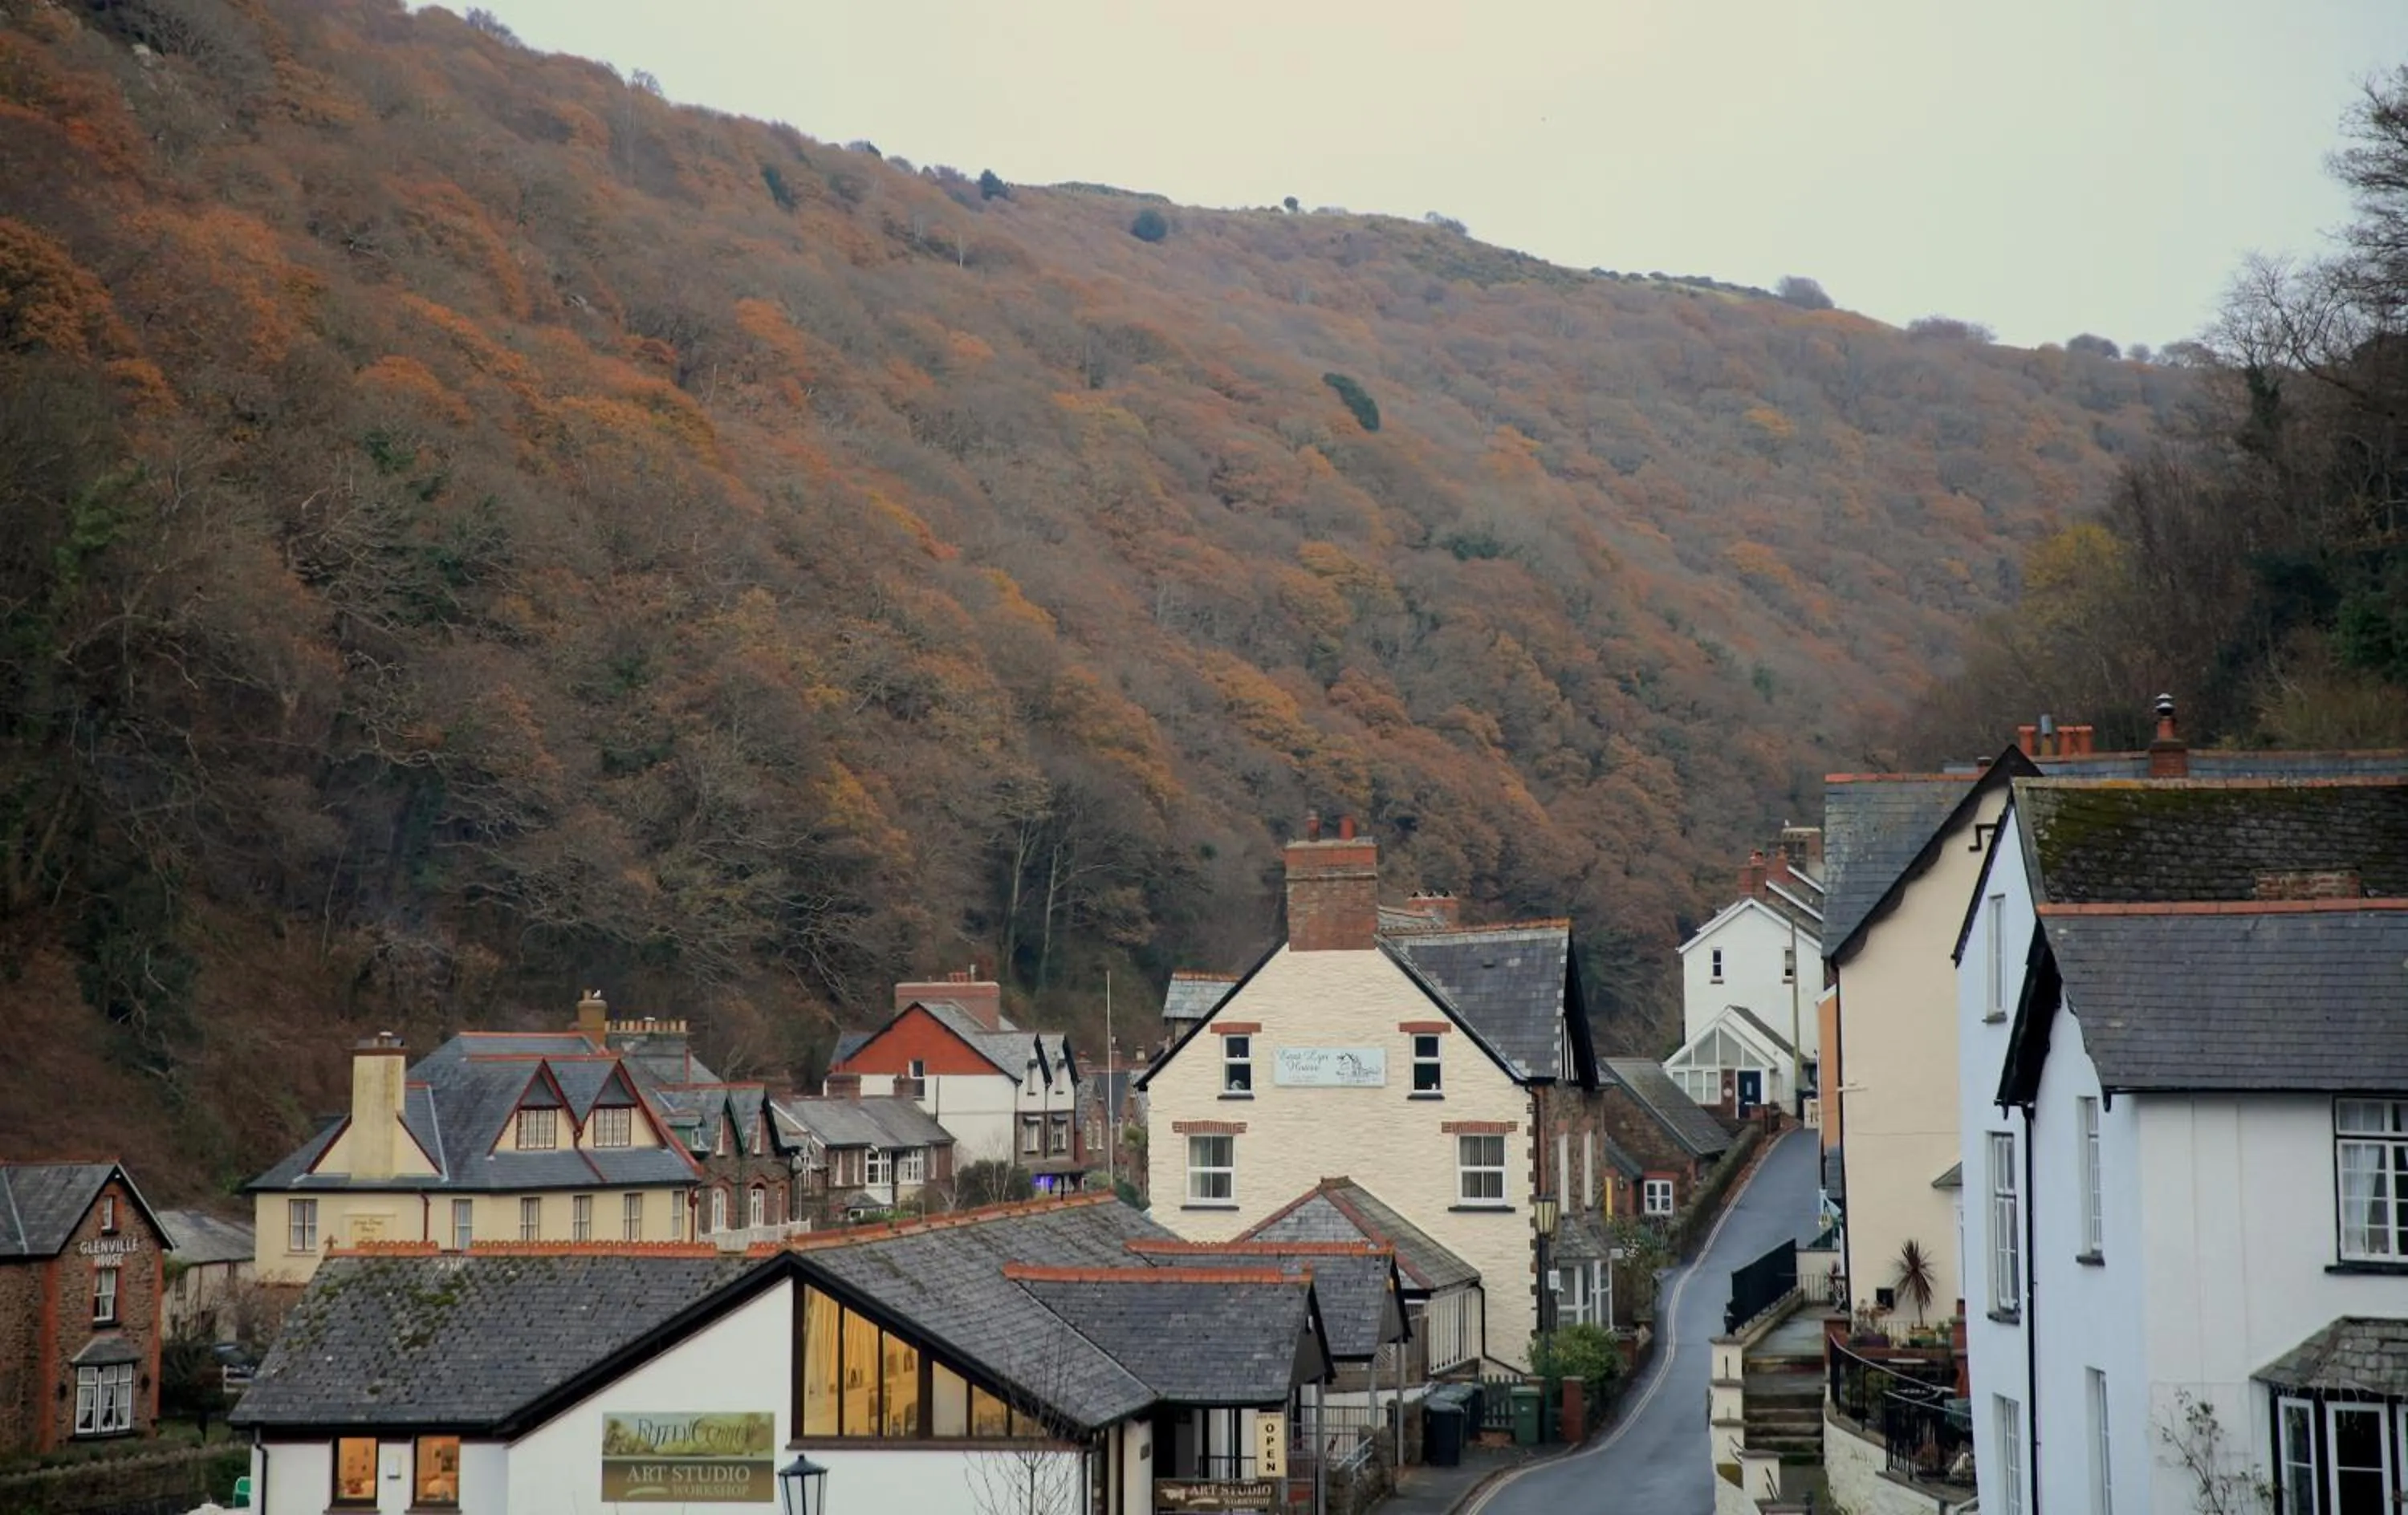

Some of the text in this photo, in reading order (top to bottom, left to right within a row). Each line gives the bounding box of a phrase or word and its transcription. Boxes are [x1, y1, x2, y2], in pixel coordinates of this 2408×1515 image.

[80, 1237, 138, 1254] GLENVILLE
[1265, 1424, 1275, 1472] OPEN
[627, 1465, 750, 1484] ART STUDIO
[673, 1485, 750, 1497] WORKSHOP
[1190, 1485, 1271, 1497] ART STUDIO
